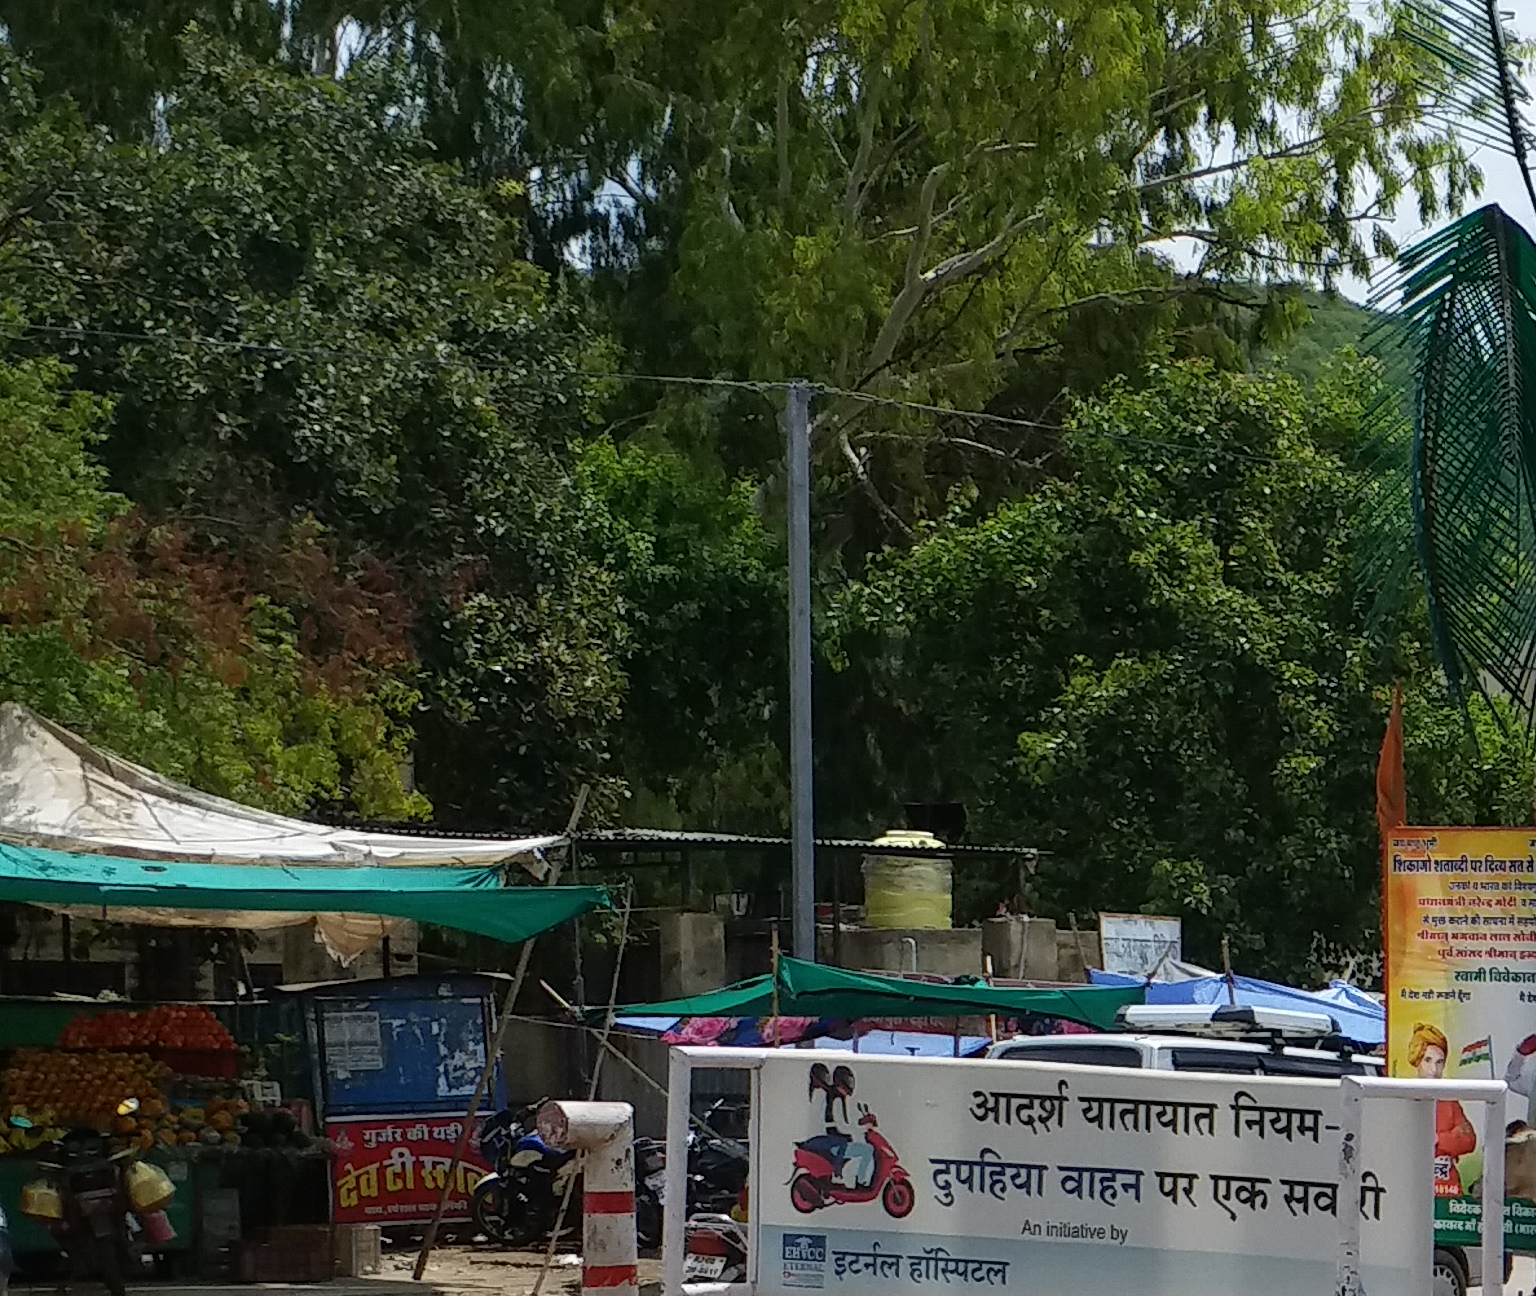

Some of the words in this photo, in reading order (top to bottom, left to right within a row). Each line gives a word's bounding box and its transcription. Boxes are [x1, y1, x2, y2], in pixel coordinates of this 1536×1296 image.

[1471, 859, 1483, 873] पर
[1485, 854, 1507, 873] दिव्य
[1526, 855, 1534, 873] से
[1495, 896, 1517, 908] मोदी
[1455, 967, 1486, 982] स्वामी
[969, 1079, 1070, 1135] आदर्श
[1078, 1094, 1218, 1138] यातायात
[363, 1125, 403, 1149] गुर्जर
[406, 1123, 430, 1142] की
[336, 1163, 380, 1208] देव
[383, 1147, 417, 1192] टी
[928, 1149, 1048, 1207] दुपहिया
[1057, 1164, 1145, 1208] वाहन
[1154, 1170, 1199, 1208] पर
[1209, 1173, 1273, 1223] एक
[1279, 1170, 1387, 1222] सवरी
[1021, 1218, 1043, 1237] An
[1045, 1220, 1107, 1240] initiative
[1109, 1223, 1130, 1246] by
[831, 1242, 903, 1281] इटर्नल
[906, 1248, 1011, 1286] हॉस्पिटल
